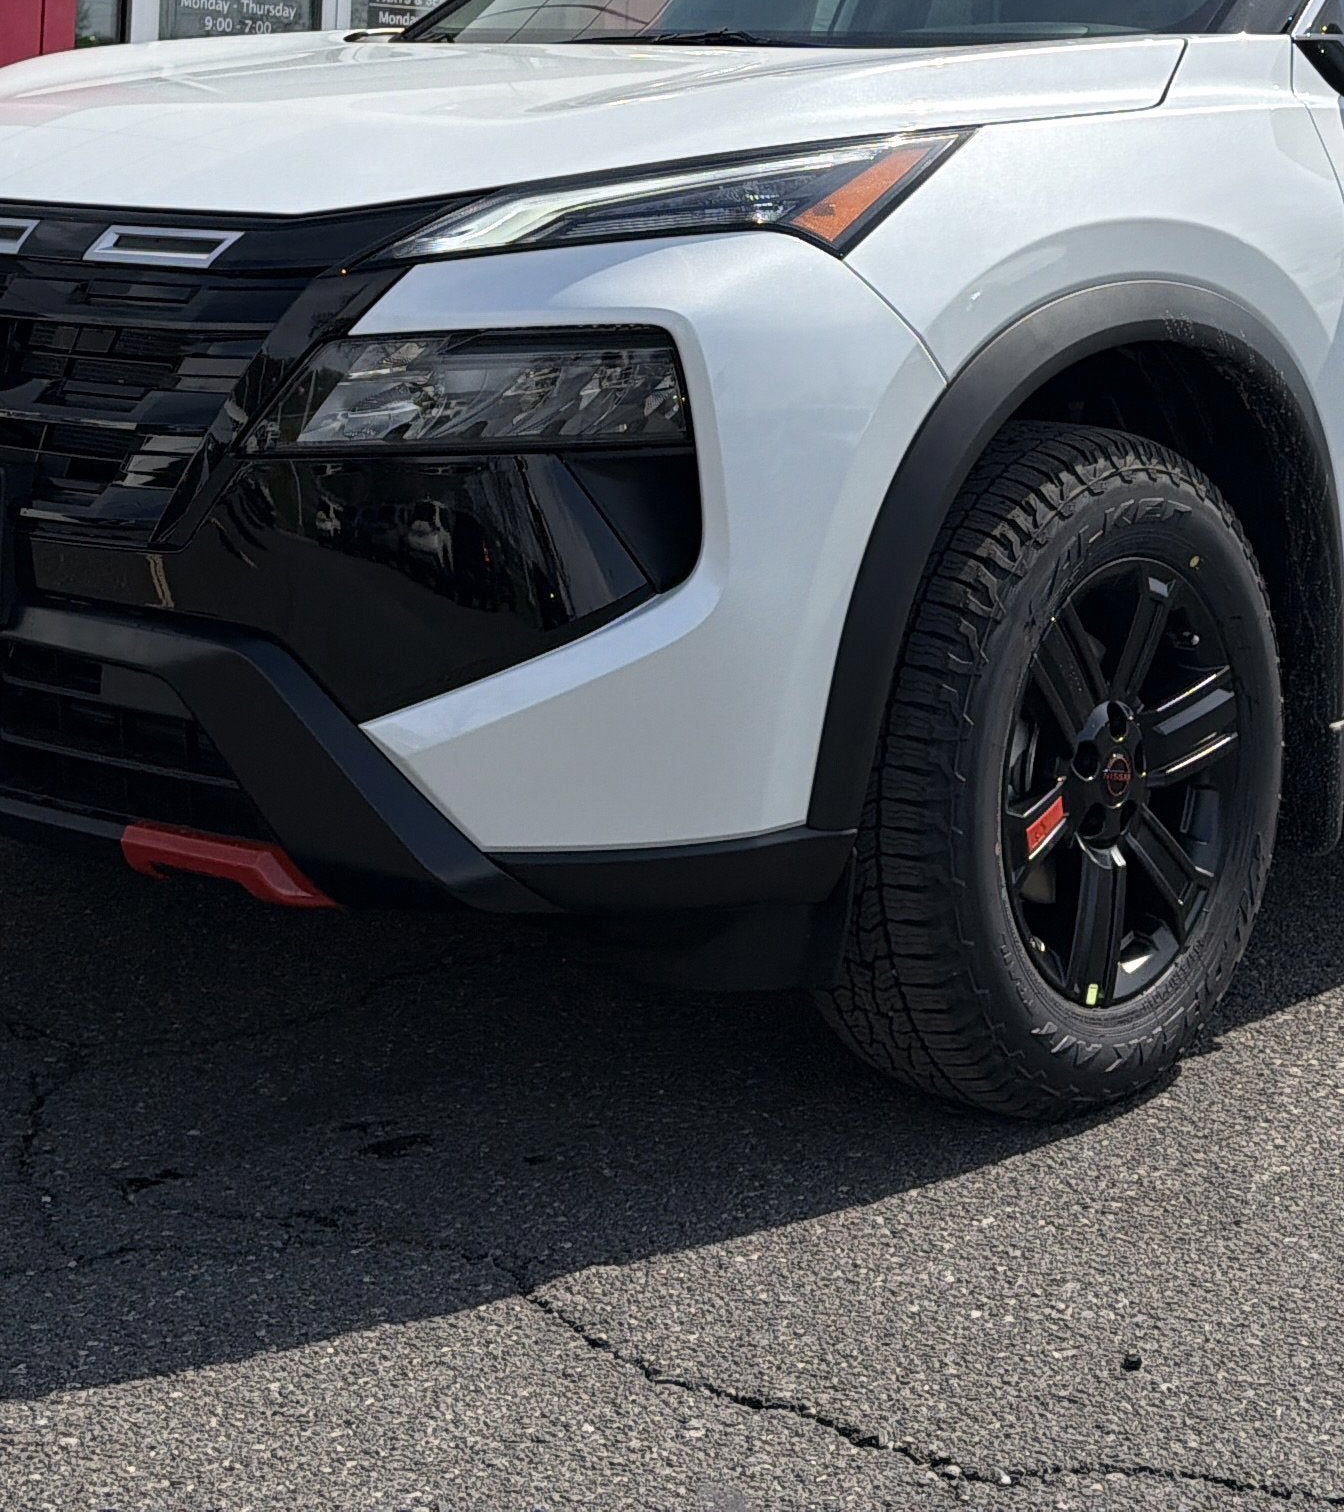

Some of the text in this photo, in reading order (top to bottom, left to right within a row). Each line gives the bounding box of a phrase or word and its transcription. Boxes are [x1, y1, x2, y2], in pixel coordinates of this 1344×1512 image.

[241, 0, 297, 20] Thursday
[378, 10, 418, 26] Monda
[204, 16, 233, 32] 9:00
[244, 19, 272, 34] 7:00
